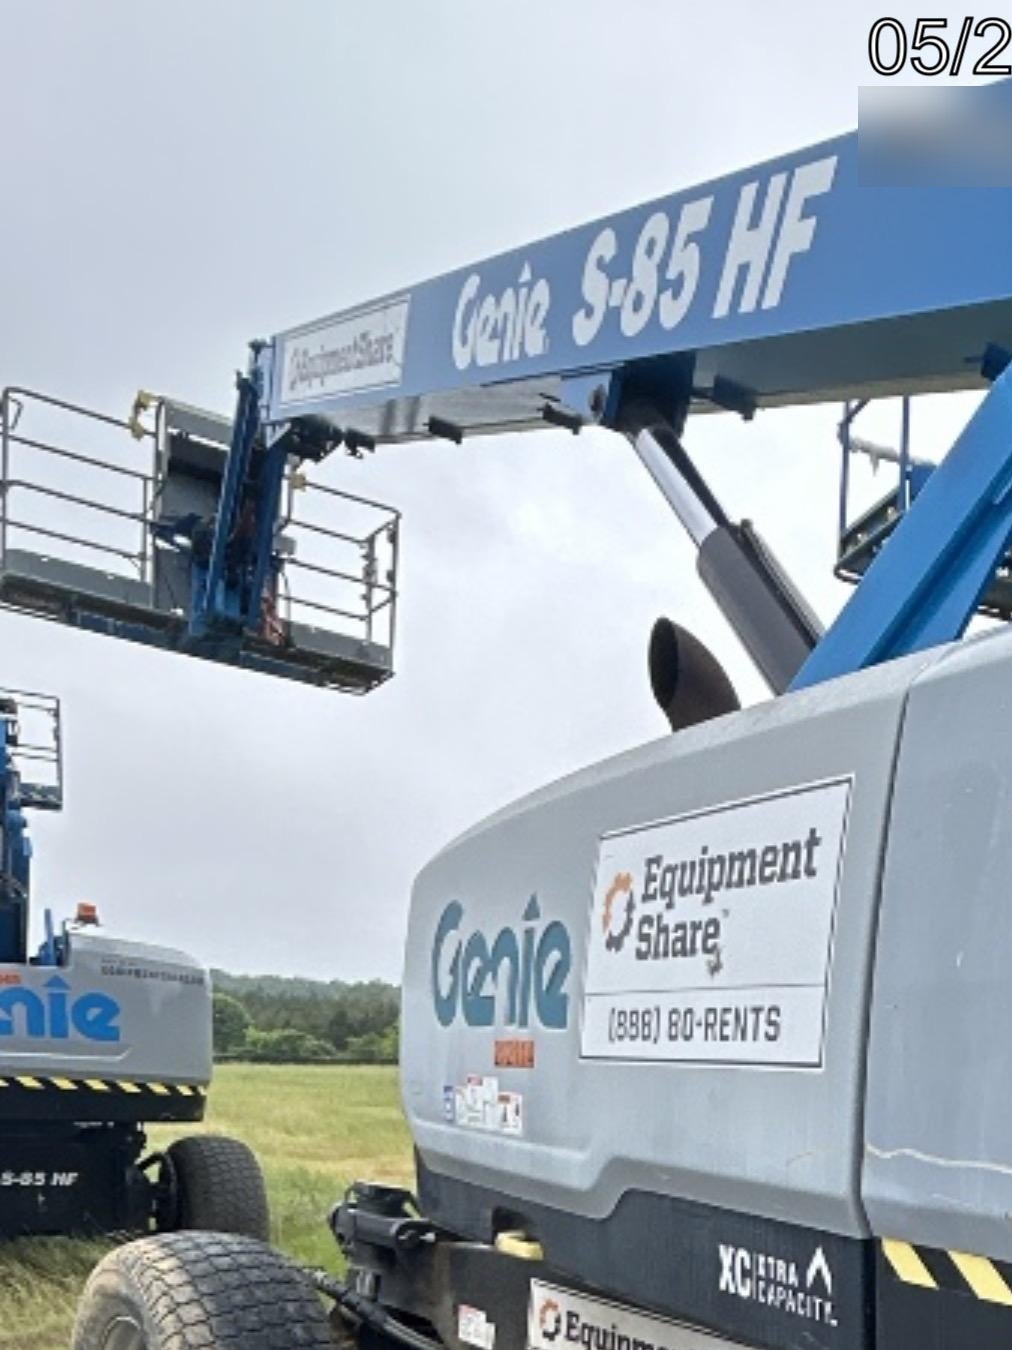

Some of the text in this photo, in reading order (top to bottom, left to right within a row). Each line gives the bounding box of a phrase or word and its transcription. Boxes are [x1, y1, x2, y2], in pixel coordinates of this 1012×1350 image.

[452, 262, 550, 371] Genie
[571, 195, 715, 347] S-85
[711, 155, 838, 319] HF
[641, 827, 822, 910] Equipment
[431, 893, 571, 1029] Genie
[635, 912, 722, 962] Share
[668, 1005, 782, 1042] 80-RENTS
[719, 1243, 752, 1299] XC
